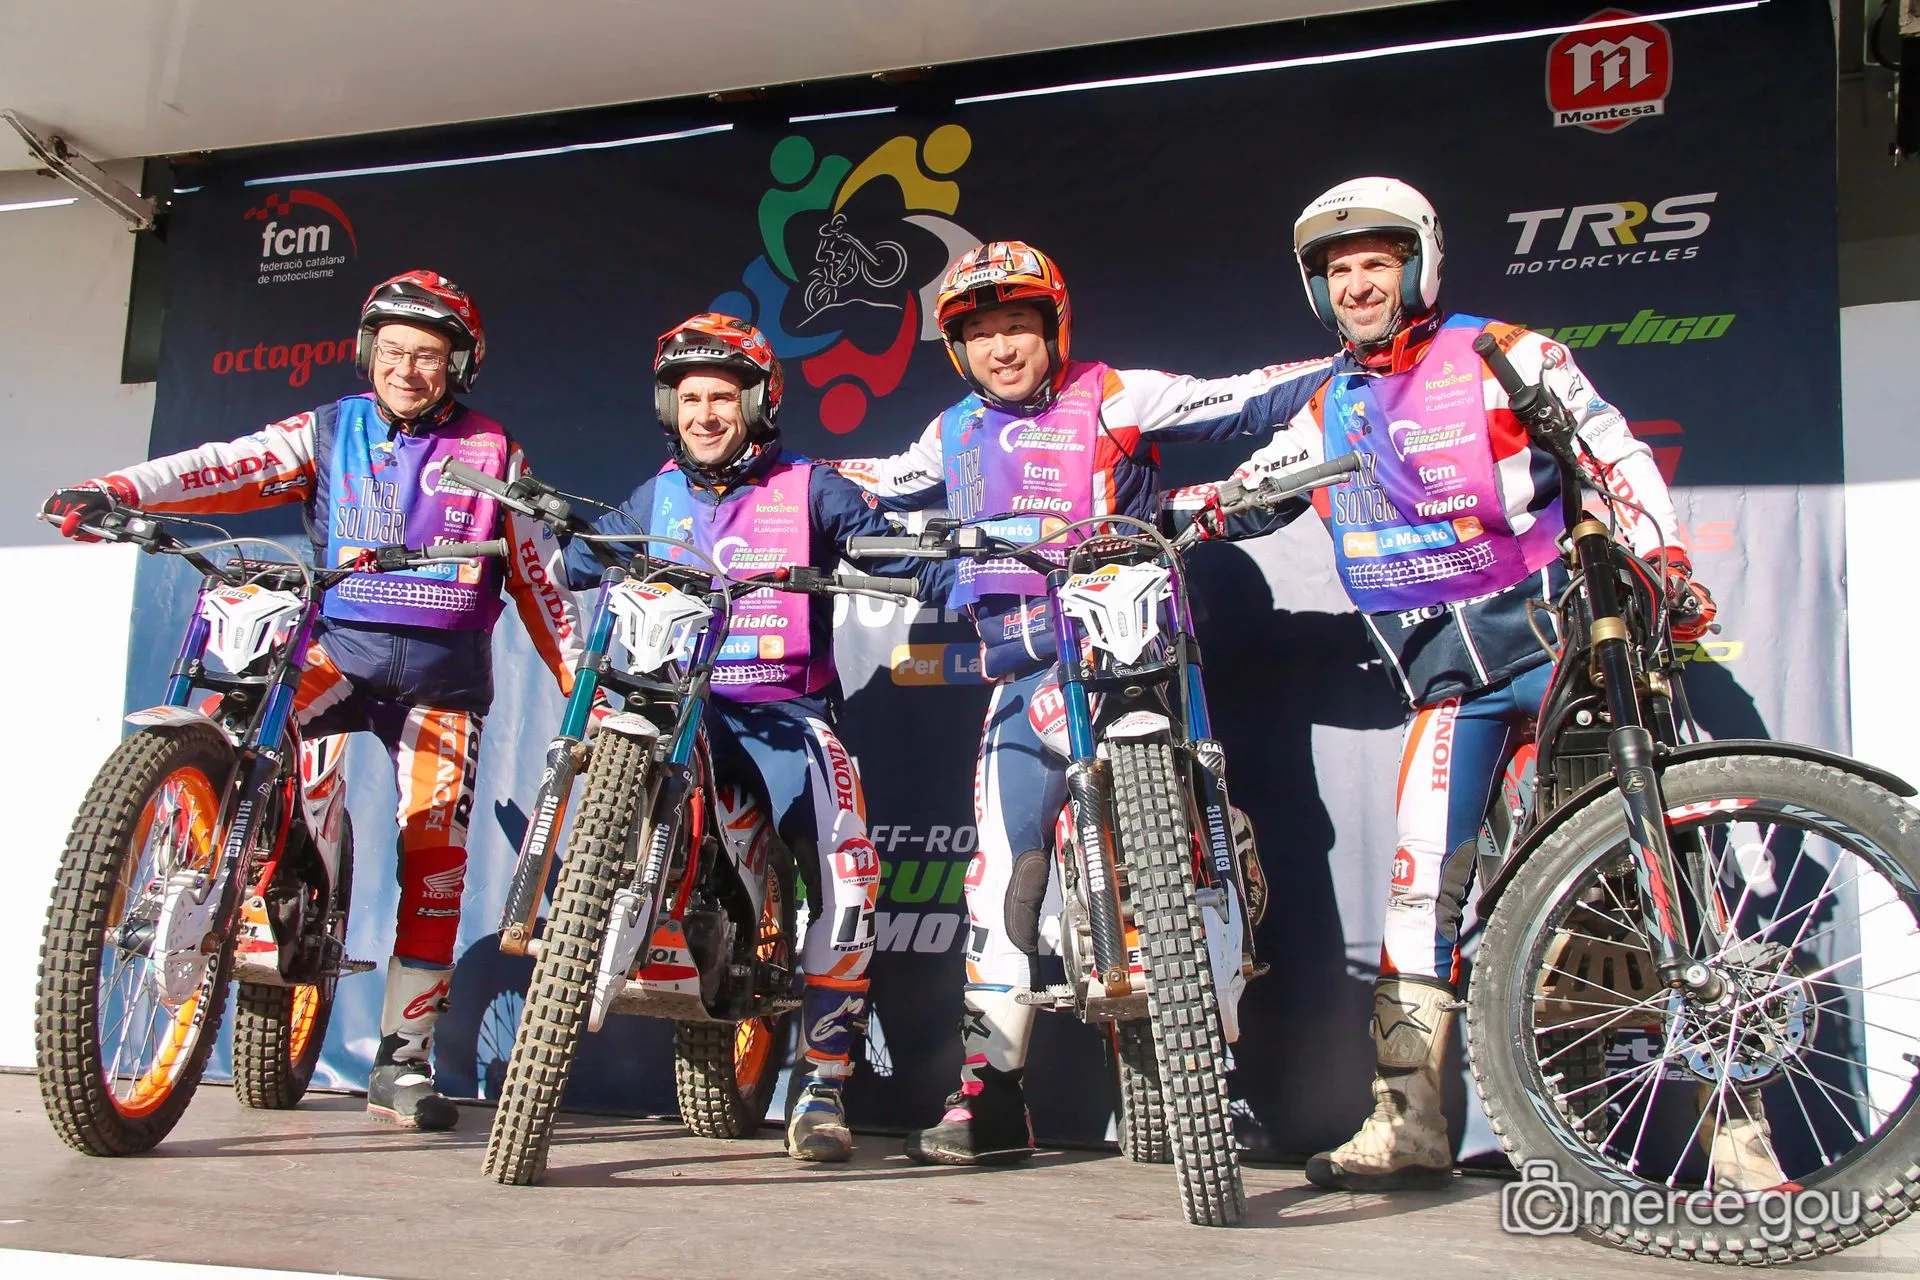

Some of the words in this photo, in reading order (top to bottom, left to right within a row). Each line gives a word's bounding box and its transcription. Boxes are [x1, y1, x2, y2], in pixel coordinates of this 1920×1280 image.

[1560, 103, 1656, 125] Montesa
[262, 221, 330, 257] fcm
[260, 257, 303, 272] federació
[305, 255, 346, 267] catalana
[1505, 246, 1700, 276] MOTORCYCLES
[257, 273, 270, 284] de
[272, 268, 334, 283] motociclisme
[672, 346, 725, 358] hebo
[1175, 393, 1233, 413] hebo
[1013, 440, 1086, 452] PARCMOTOR
[1018, 432, 1076, 443] CIRCUIT
[1403, 433, 1477, 456] PARCMOTOR
[1404, 428, 1464, 446] CIRCUIT
[1254, 449, 1309, 473] hebo
[178, 450, 283, 492] HONDA
[1023, 461, 1060, 481] fcm
[1418, 464, 1456, 485] fcm
[1012, 495, 1073, 512] TrialGo
[1415, 494, 1478, 517] TrialGo
[445, 506, 475, 525] fcm
[1380, 536, 1393, 549] La
[731, 553, 786, 562] CIRCUIT
[519, 538, 572, 641] HONDA
[621, 584, 668, 597] REPSOL
[1069, 574, 1117, 589] REPSOL
[213, 588, 253, 601] REPSOL
[729, 614, 789, 628] TrialGo
[720, 641, 751, 654] rató
[898, 656, 939, 675] Per
[1043, 717, 1066, 736] Monte
[1432, 697, 1458, 793] HOND
[425, 713, 459, 831] HONDA
[1207, 805, 1229, 858] BRAKTEC
[648, 823, 670, 873] BRAKTEC
[1083, 825, 1104, 879] BRAKTEC
[842, 876, 876, 885] Montesa
[192, 954, 219, 1026] REPSO
